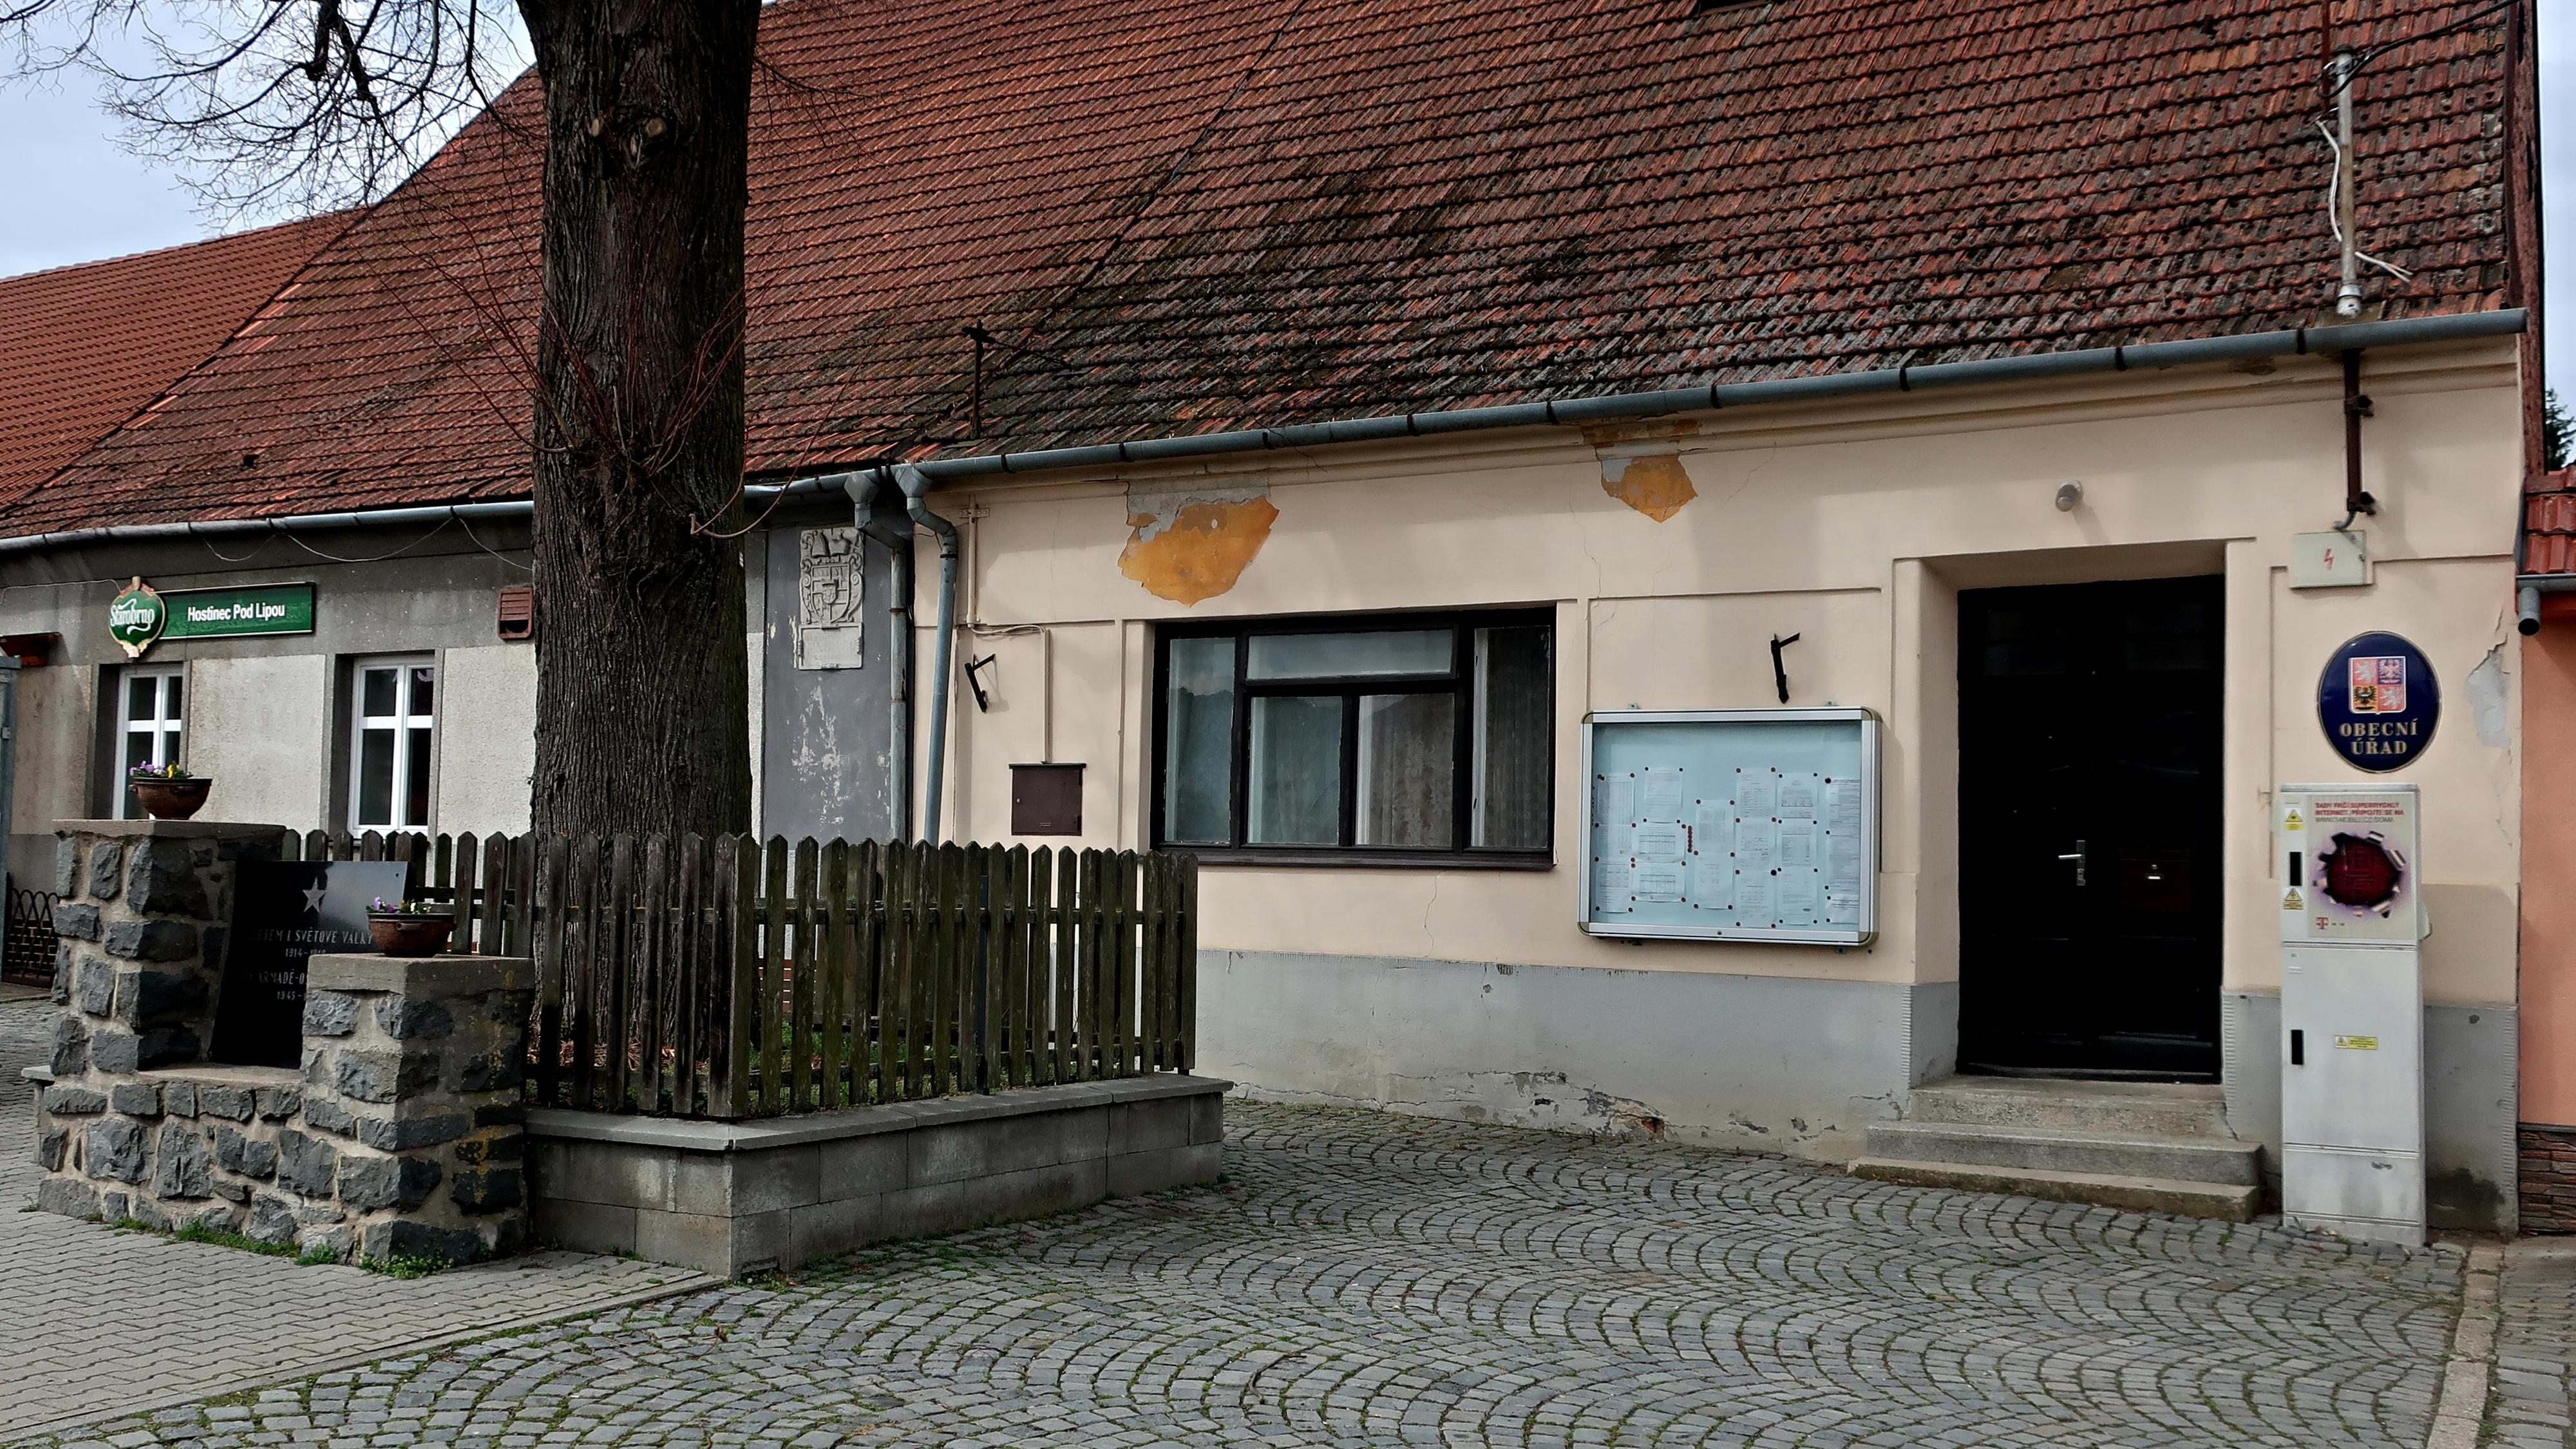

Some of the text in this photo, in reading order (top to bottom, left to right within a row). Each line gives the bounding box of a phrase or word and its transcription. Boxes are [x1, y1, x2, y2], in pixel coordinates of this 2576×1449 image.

[187, 602, 285, 621] Hostinec Pod Lipou
[2339, 719, 2418, 737] OBECNÍ
[2352, 738, 2407, 755] ÚŘAD
